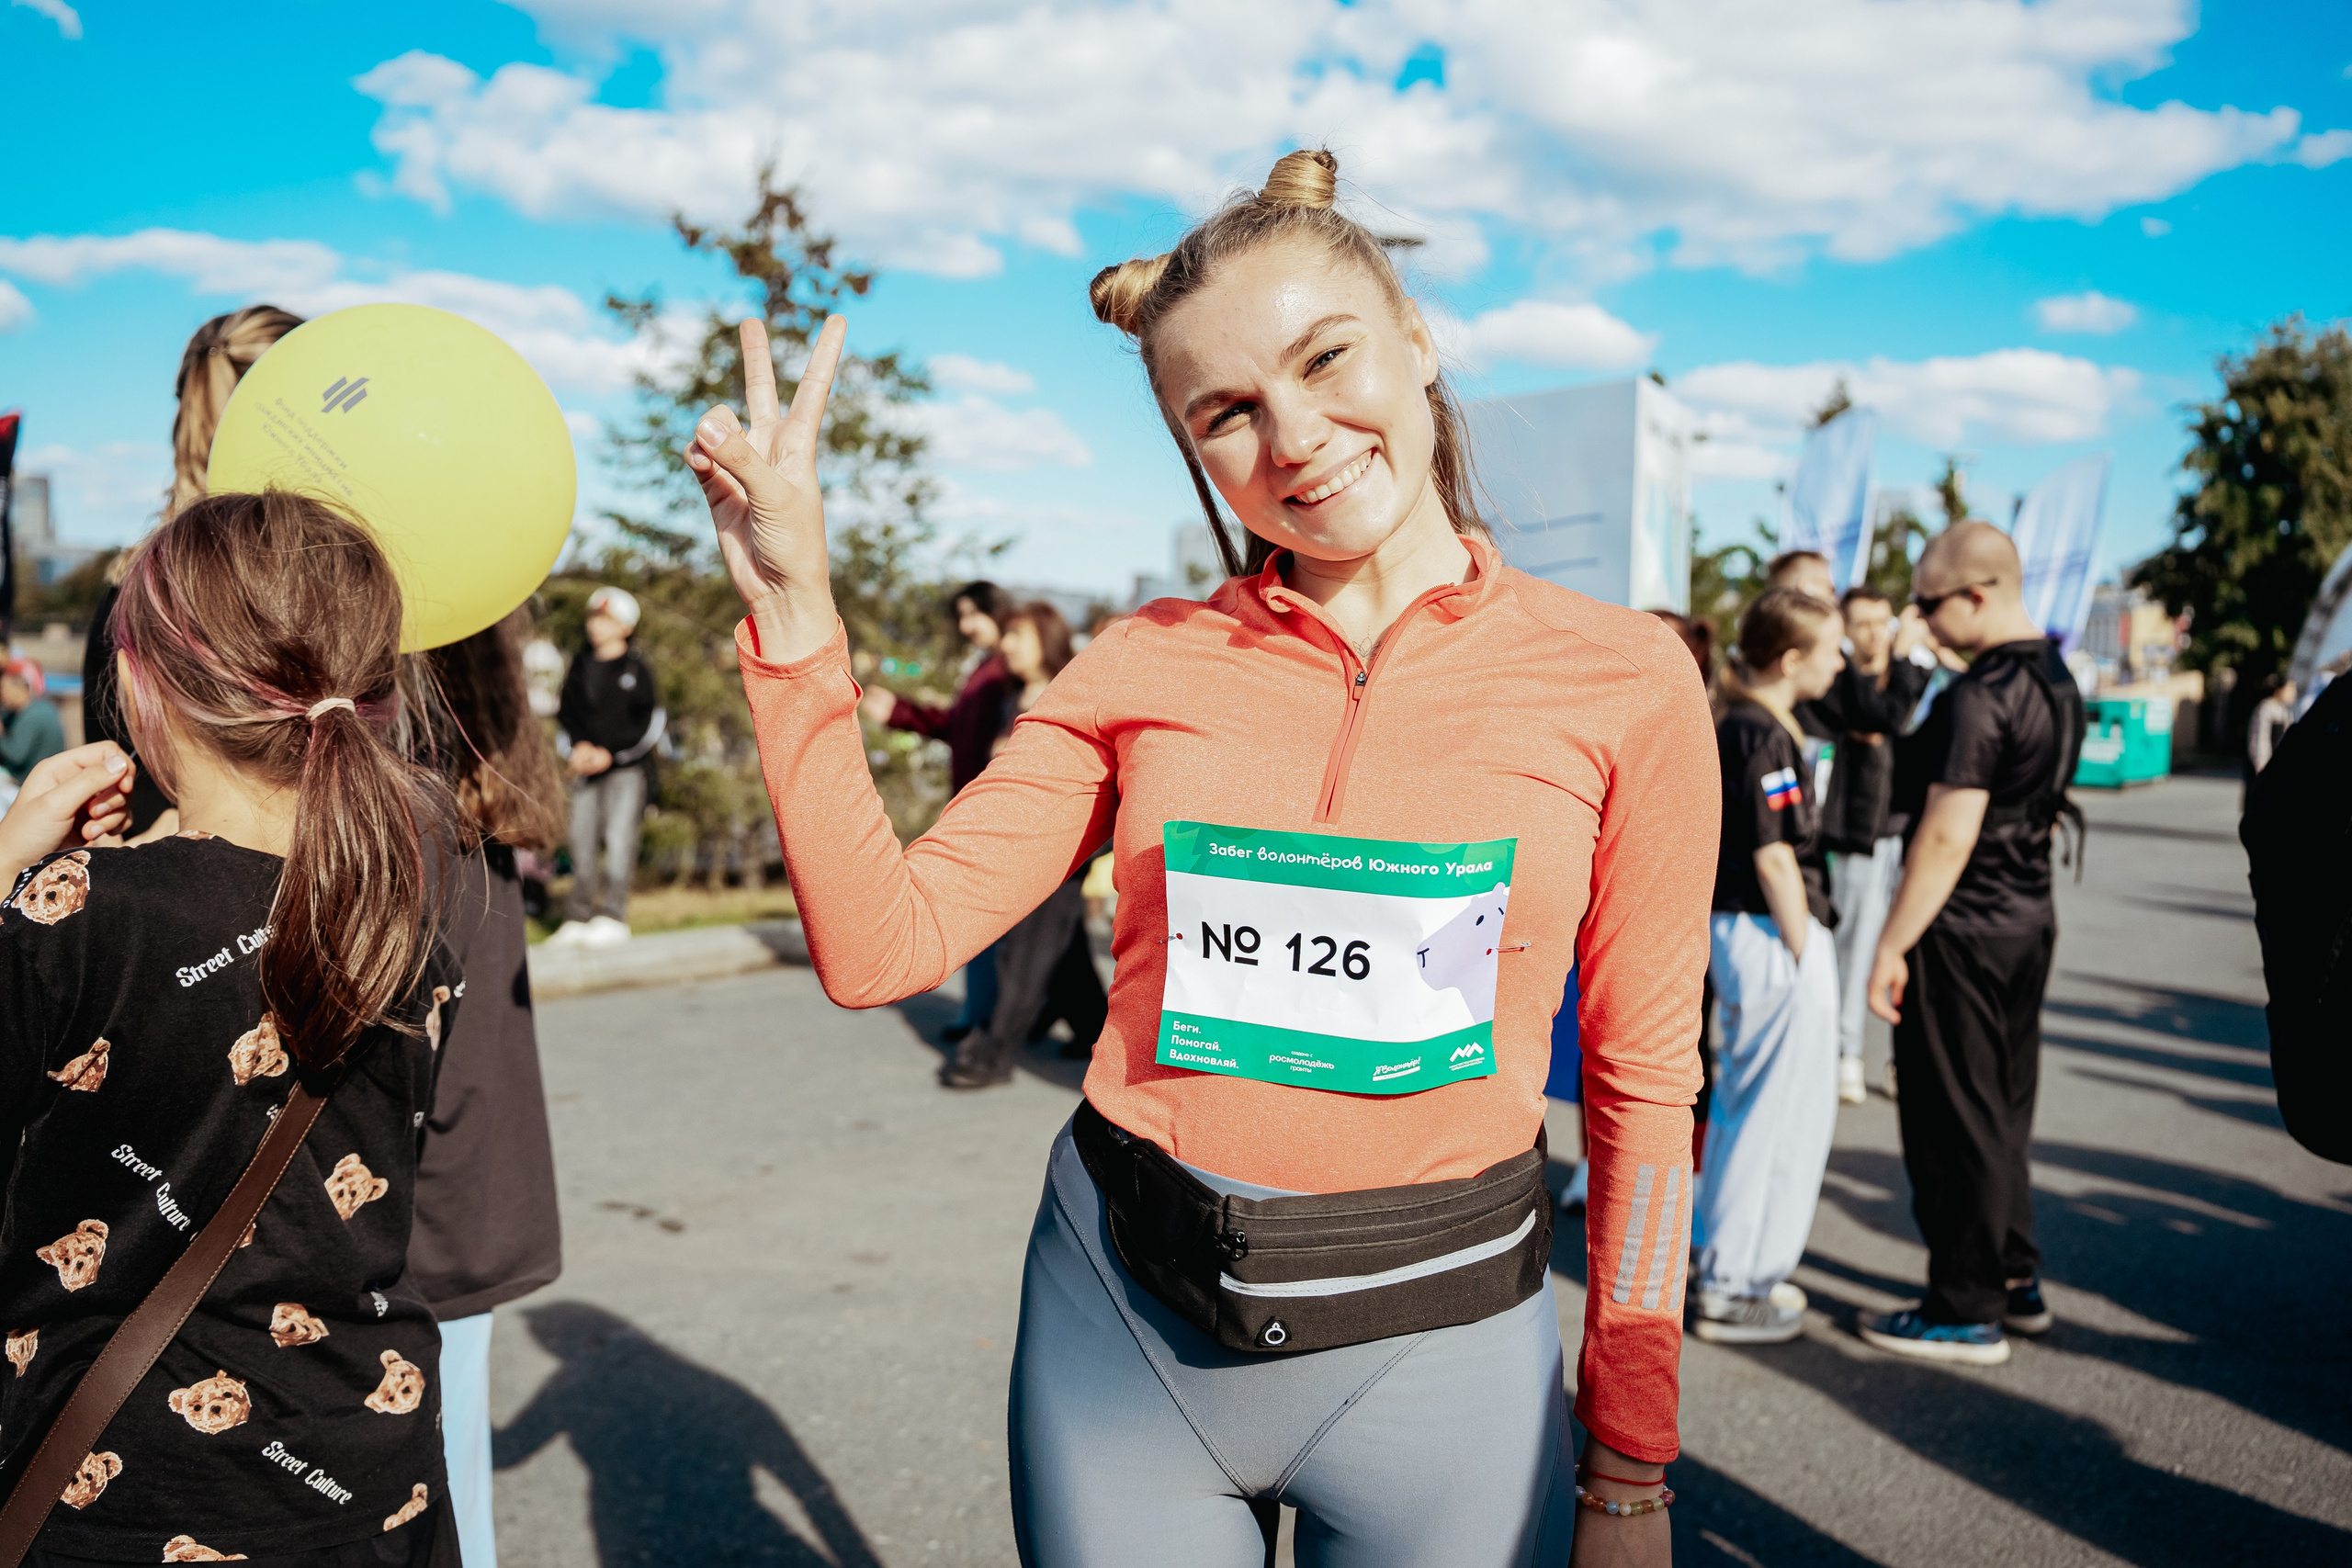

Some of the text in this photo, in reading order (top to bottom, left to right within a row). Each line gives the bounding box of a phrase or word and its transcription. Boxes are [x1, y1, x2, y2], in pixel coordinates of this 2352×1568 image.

[1209, 842, 1493, 877] Забег волонтёров Южного Урала
[175, 947, 235, 987] Street
[1285, 932, 1371, 981] 126
[1170, 1034, 1222, 1052] Помогай.
[1172, 1021, 1202, 1034] Беги.
[1169, 1048, 1239, 1069] Вдохновляй.
[1269, 1055, 1335, 1069] росмолодёжь
[110, 1144, 191, 1232] Street Culture
[261, 1440, 353, 1505] Street Culture
